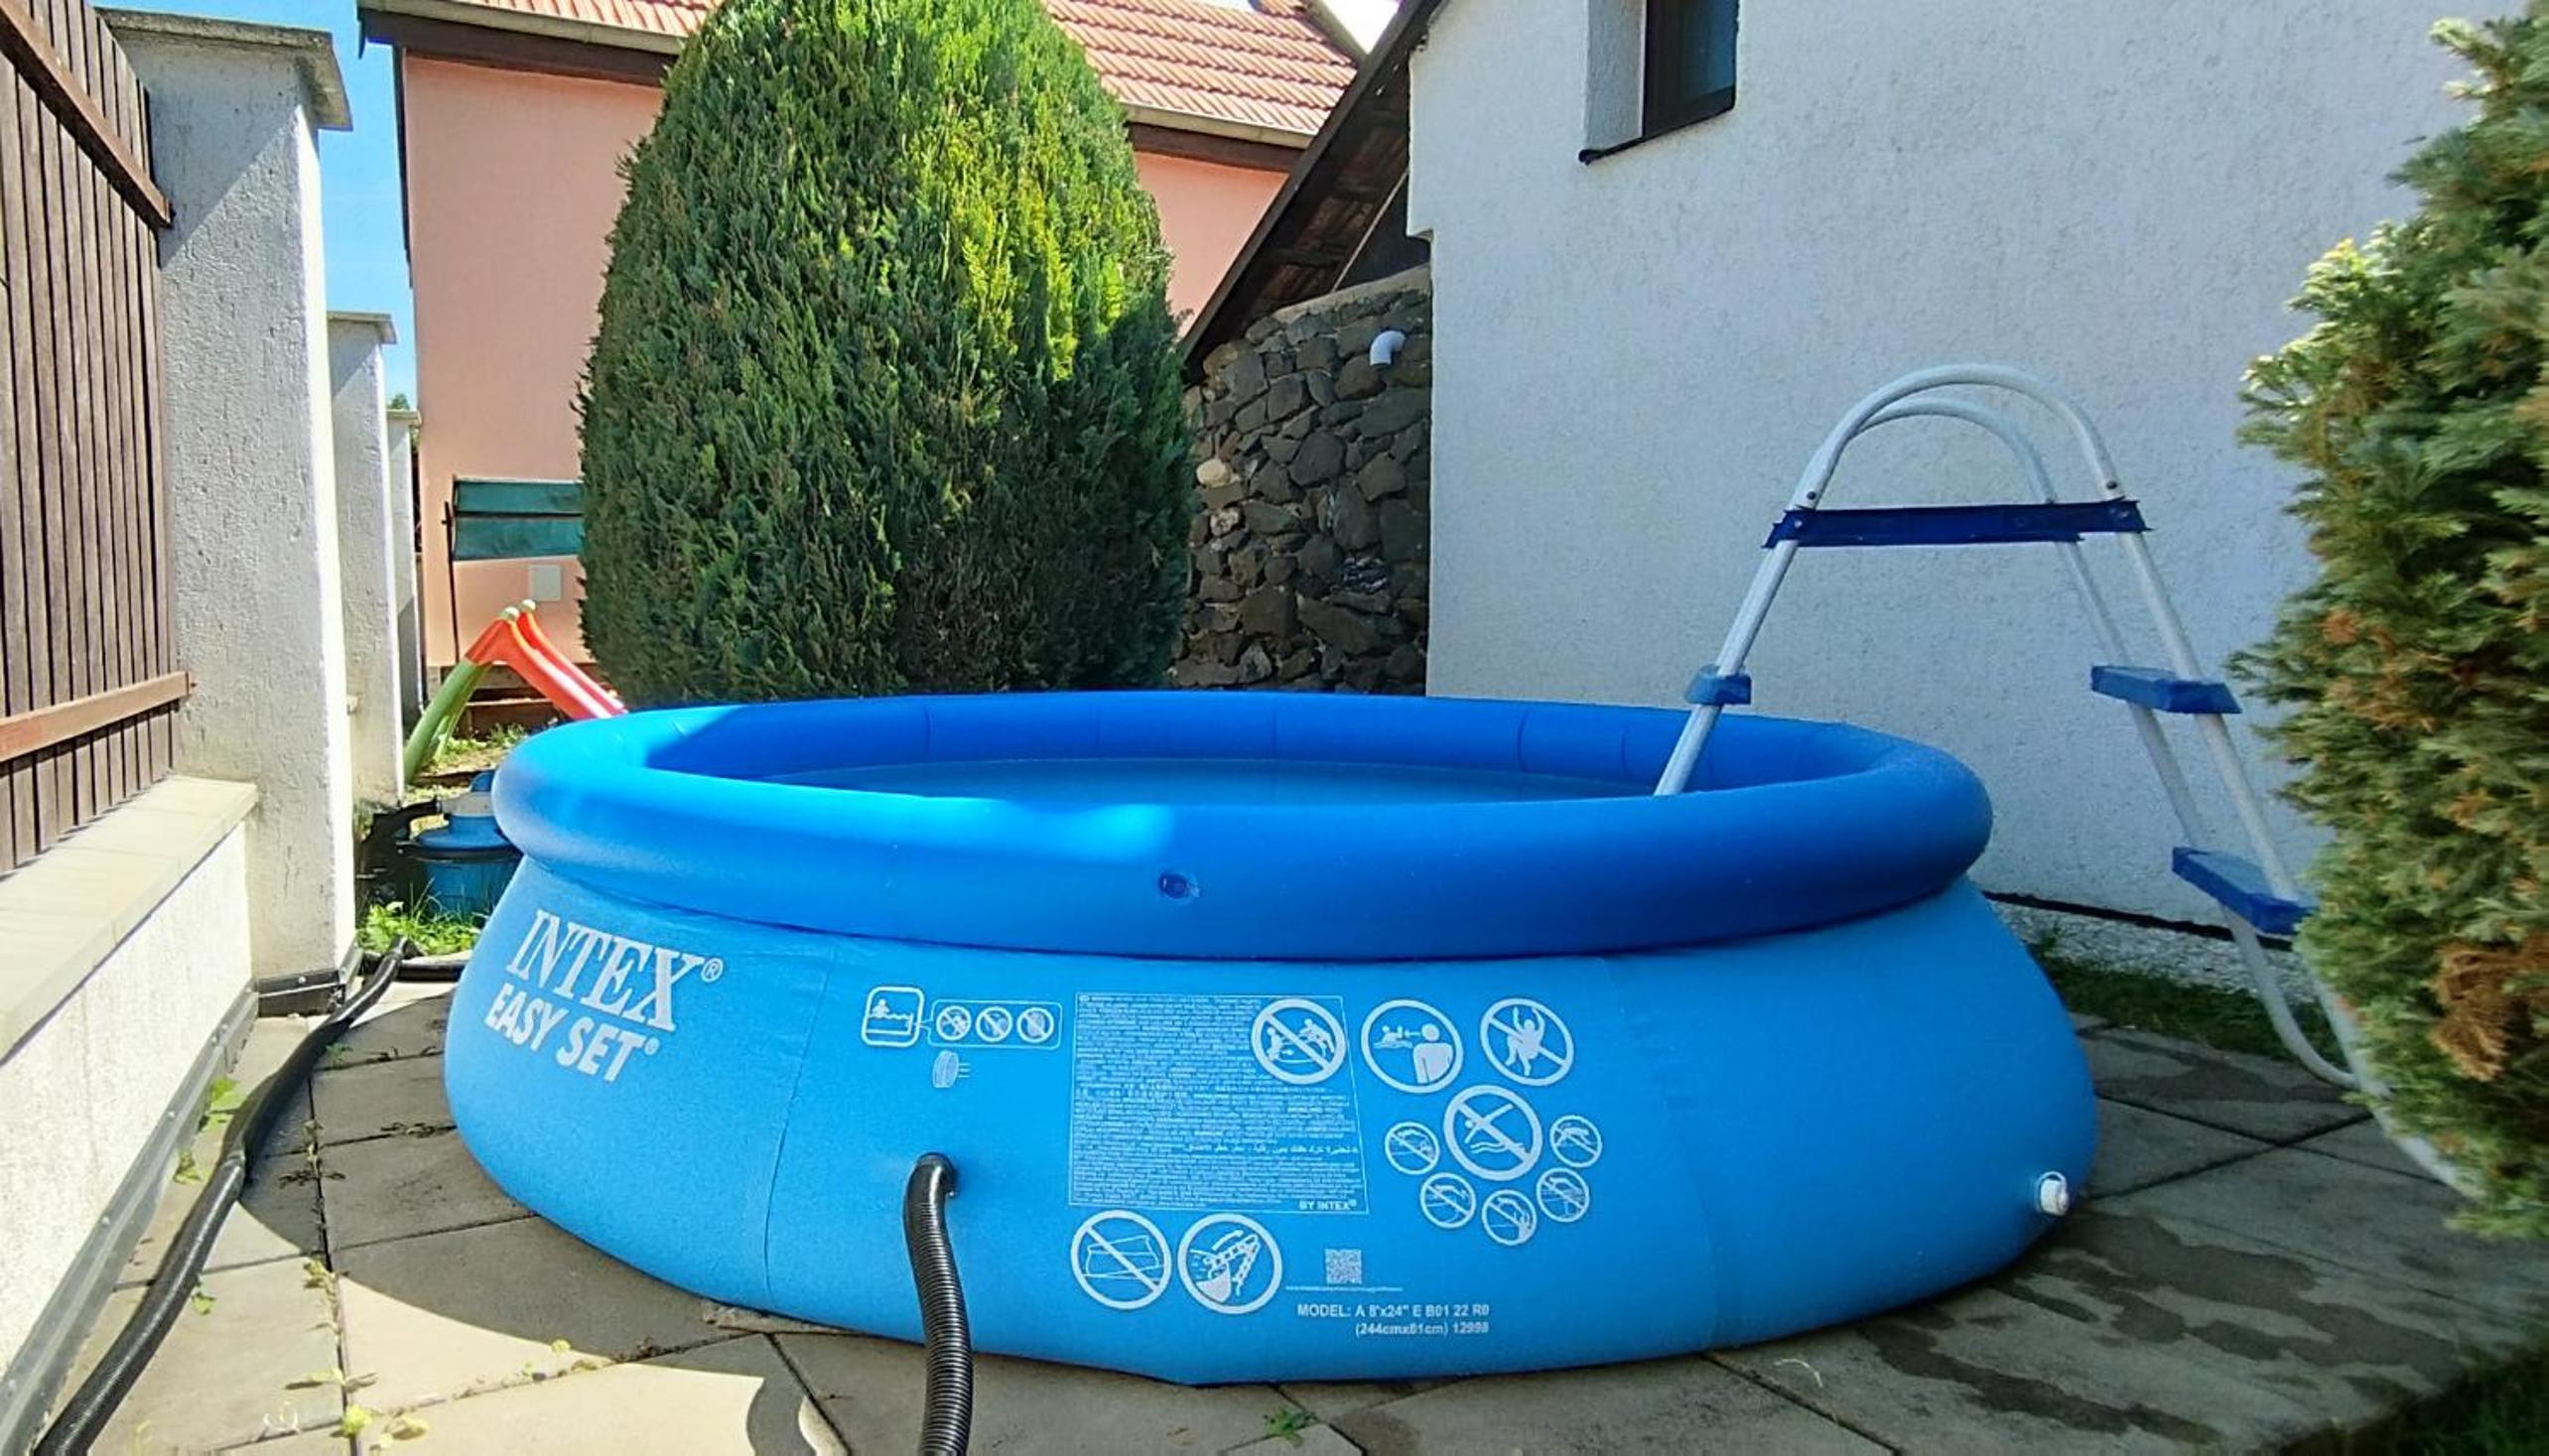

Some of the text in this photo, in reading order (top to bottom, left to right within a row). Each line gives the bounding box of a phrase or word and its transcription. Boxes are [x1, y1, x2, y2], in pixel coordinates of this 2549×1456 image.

[484, 983, 568, 1051] EASY
[1299, 1200, 1315, 1210] BY
[1297, 1304, 1351, 1317] MODEL:
[1355, 1305, 1366, 1317] A
[1412, 1305, 1421, 1317] E
[1425, 1305, 1449, 1317] B01
[1454, 1305, 1468, 1316] 22
